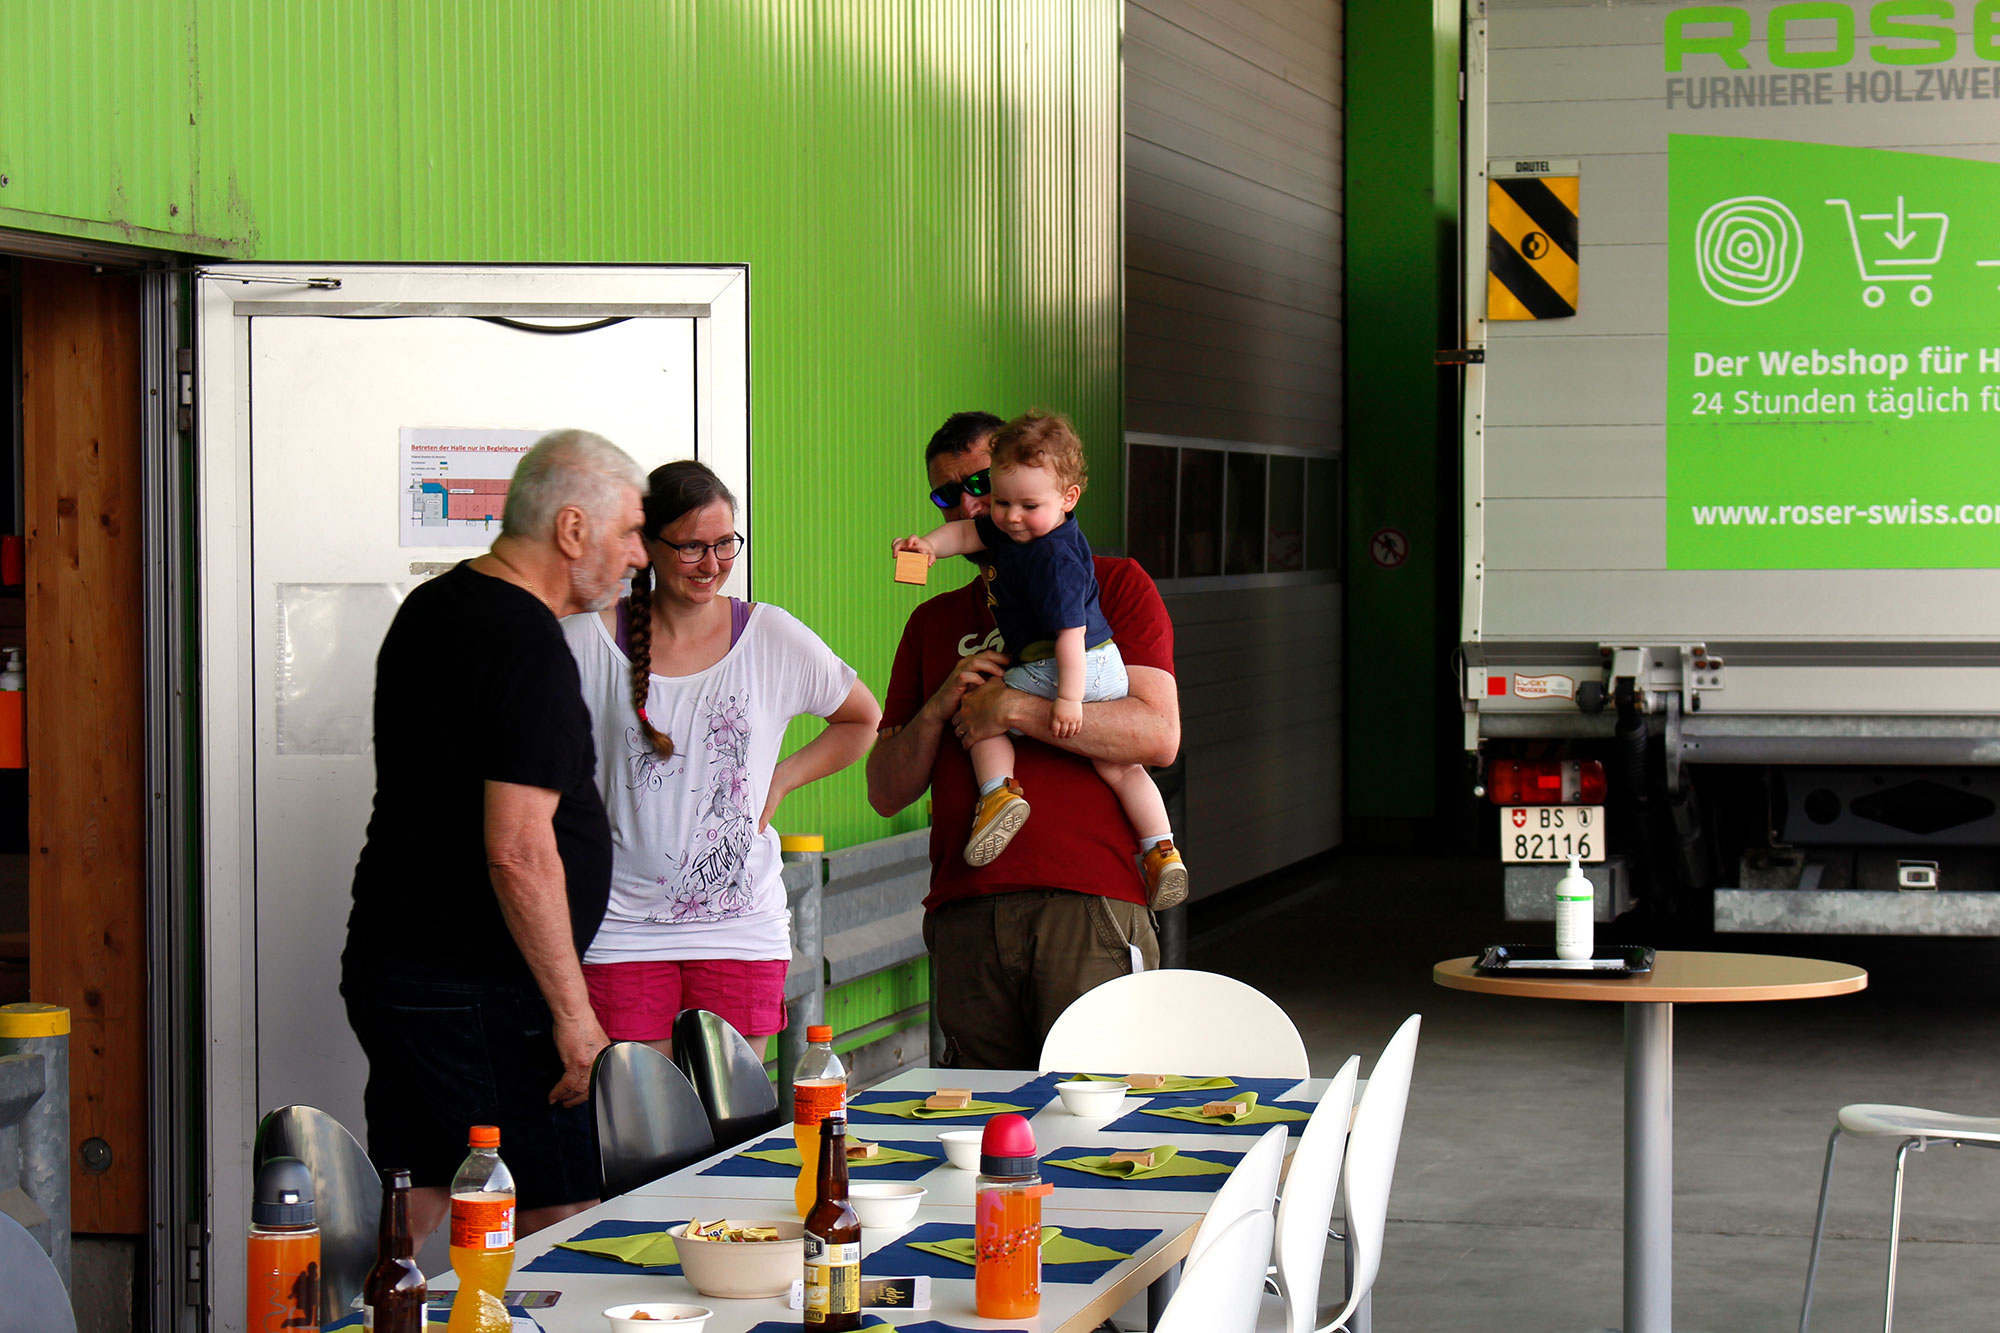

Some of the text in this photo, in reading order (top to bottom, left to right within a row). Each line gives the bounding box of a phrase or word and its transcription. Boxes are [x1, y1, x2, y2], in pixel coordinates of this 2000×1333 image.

[1665, 72, 1833, 110] FURNIERE
[1515, 161, 1550, 173] DAUTEL
[1694, 351, 1749, 377] Der
[1758, 348, 1908, 380] Webshop
[1919, 346, 1968, 374] für
[1692, 392, 1724, 415] 24
[1733, 388, 1856, 414] Stunden
[1866, 386, 1969, 419] täglich
[487, 445, 519, 453] Begleitung
[1540, 809, 1564, 828] BS
[1515, 833, 1591, 859] 82116
